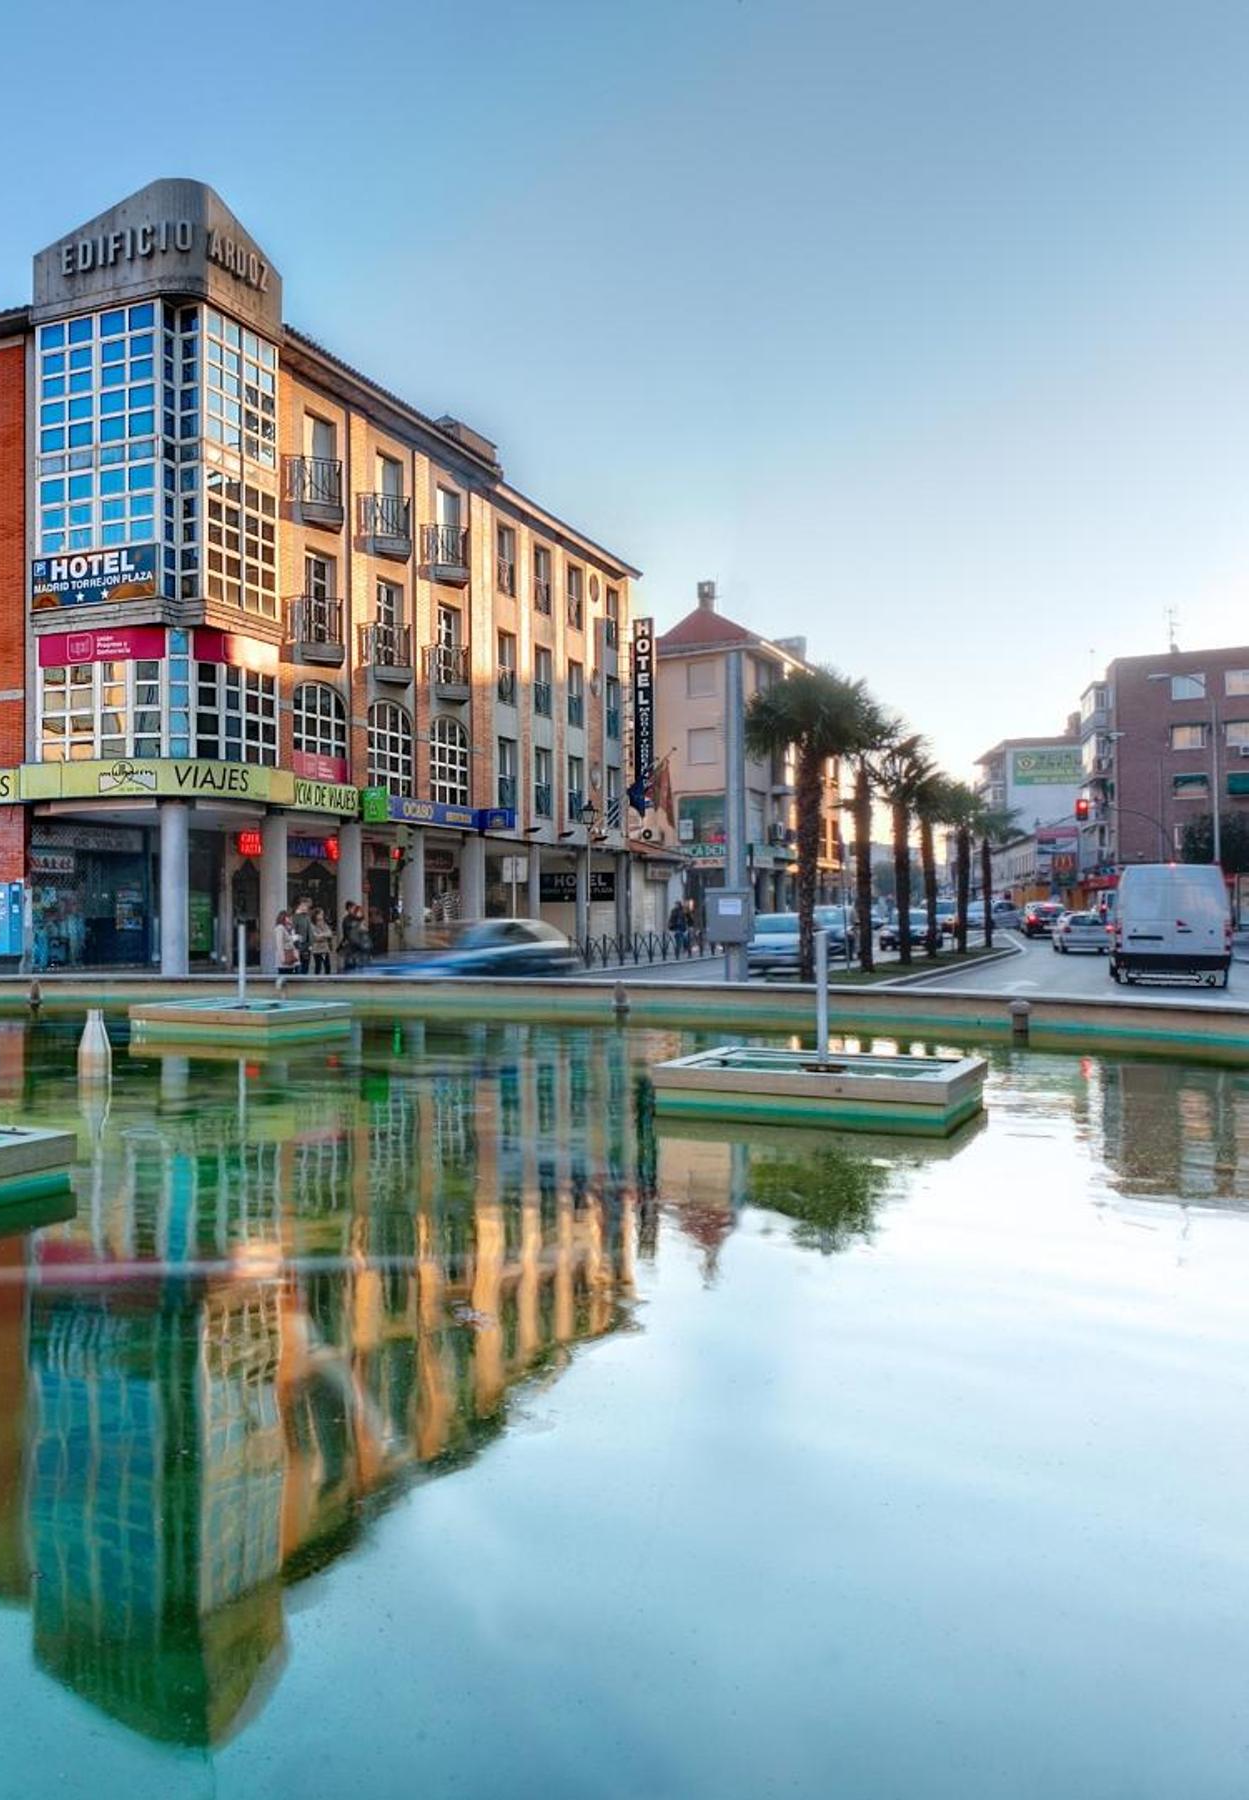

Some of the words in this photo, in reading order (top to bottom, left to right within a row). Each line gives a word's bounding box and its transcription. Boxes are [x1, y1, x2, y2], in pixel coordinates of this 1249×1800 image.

[61, 219, 193, 276] EDIFICIO
[208, 228, 268, 293] ARDOZ
[51, 550, 135, 581] HOTEL
[34, 582, 69, 593] MADRID
[122, 571, 153, 583] PLAZA
[636, 620, 651, 705] HOTEL
[175, 765, 250, 792] VIAJES
[315, 785, 327, 806] DE
[554, 874, 607, 887] HOEL
